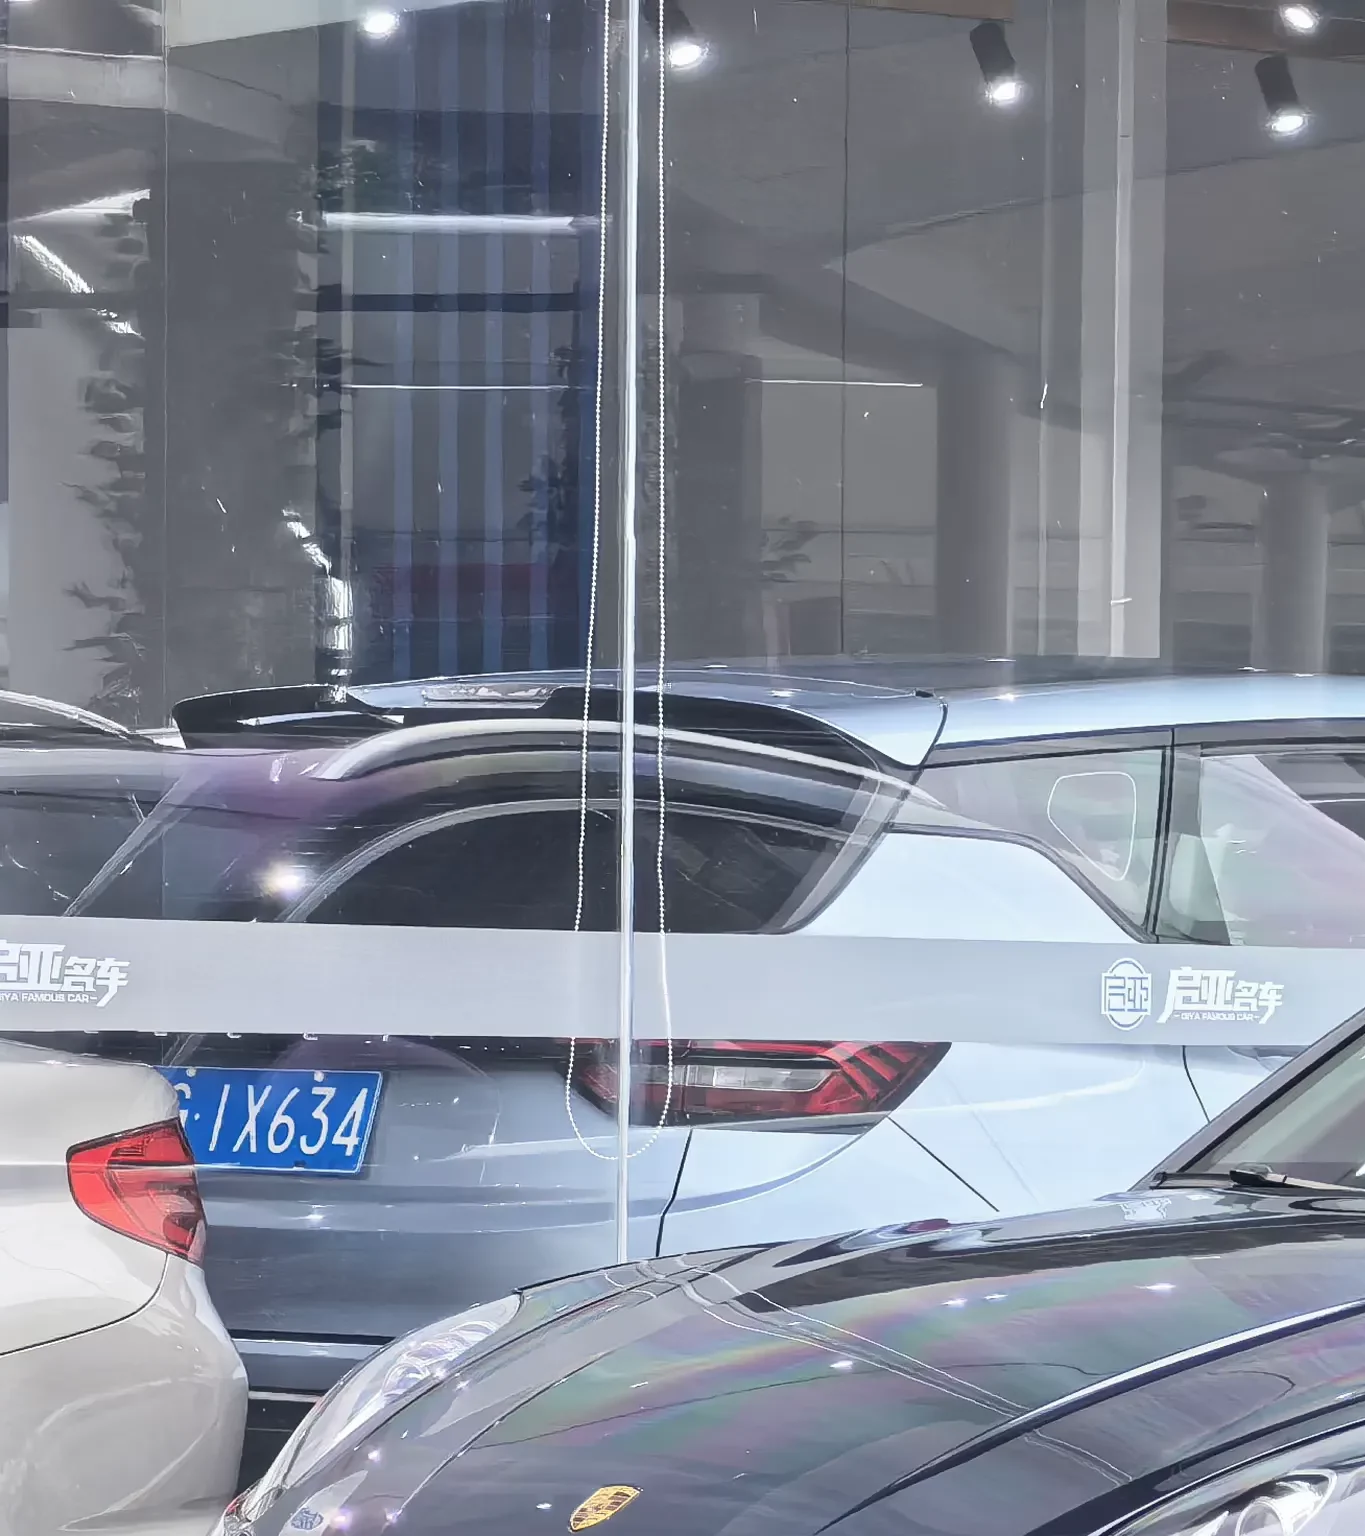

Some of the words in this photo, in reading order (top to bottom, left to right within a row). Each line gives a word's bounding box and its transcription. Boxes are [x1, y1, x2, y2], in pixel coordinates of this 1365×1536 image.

[21, 992, 65, 1002] FAMOUS
[67, 993, 89, 1003] CAR
[1156, 966, 1285, 1024] 启亚名车
[1236, 1013, 1254, 1021] CAR
